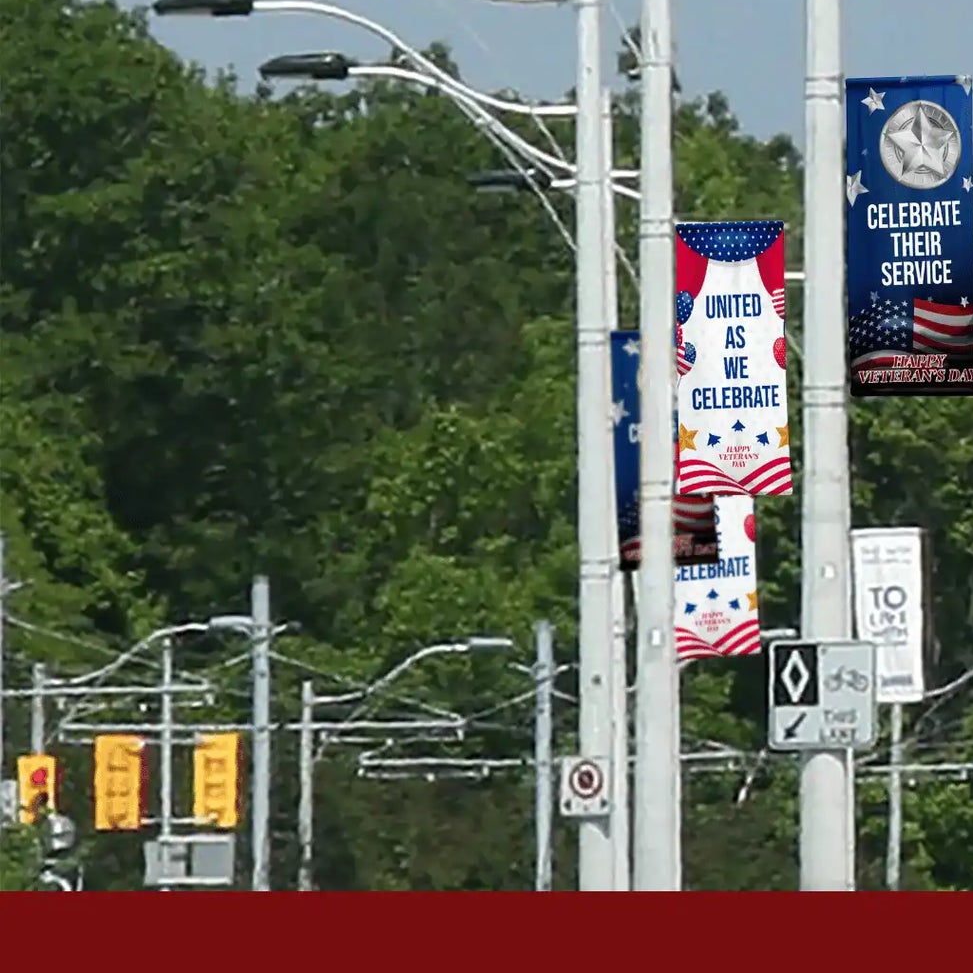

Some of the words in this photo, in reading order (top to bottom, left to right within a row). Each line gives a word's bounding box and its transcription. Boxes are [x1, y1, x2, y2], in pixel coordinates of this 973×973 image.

[866, 200, 962, 230] CELEBRATE
[890, 231, 942, 258] THEIR
[881, 259, 953, 287] SERVICE
[705, 293, 762, 320] UNITED
[724, 325, 746, 350] AS
[723, 355, 749, 380] WE
[891, 353, 948, 369] HAPPY
[858, 368, 946, 385] VETERAN'S
[691, 384, 780, 410] CELEBRATE
[725, 445, 752, 454] HAPPY
[868, 586, 908, 610] TO
